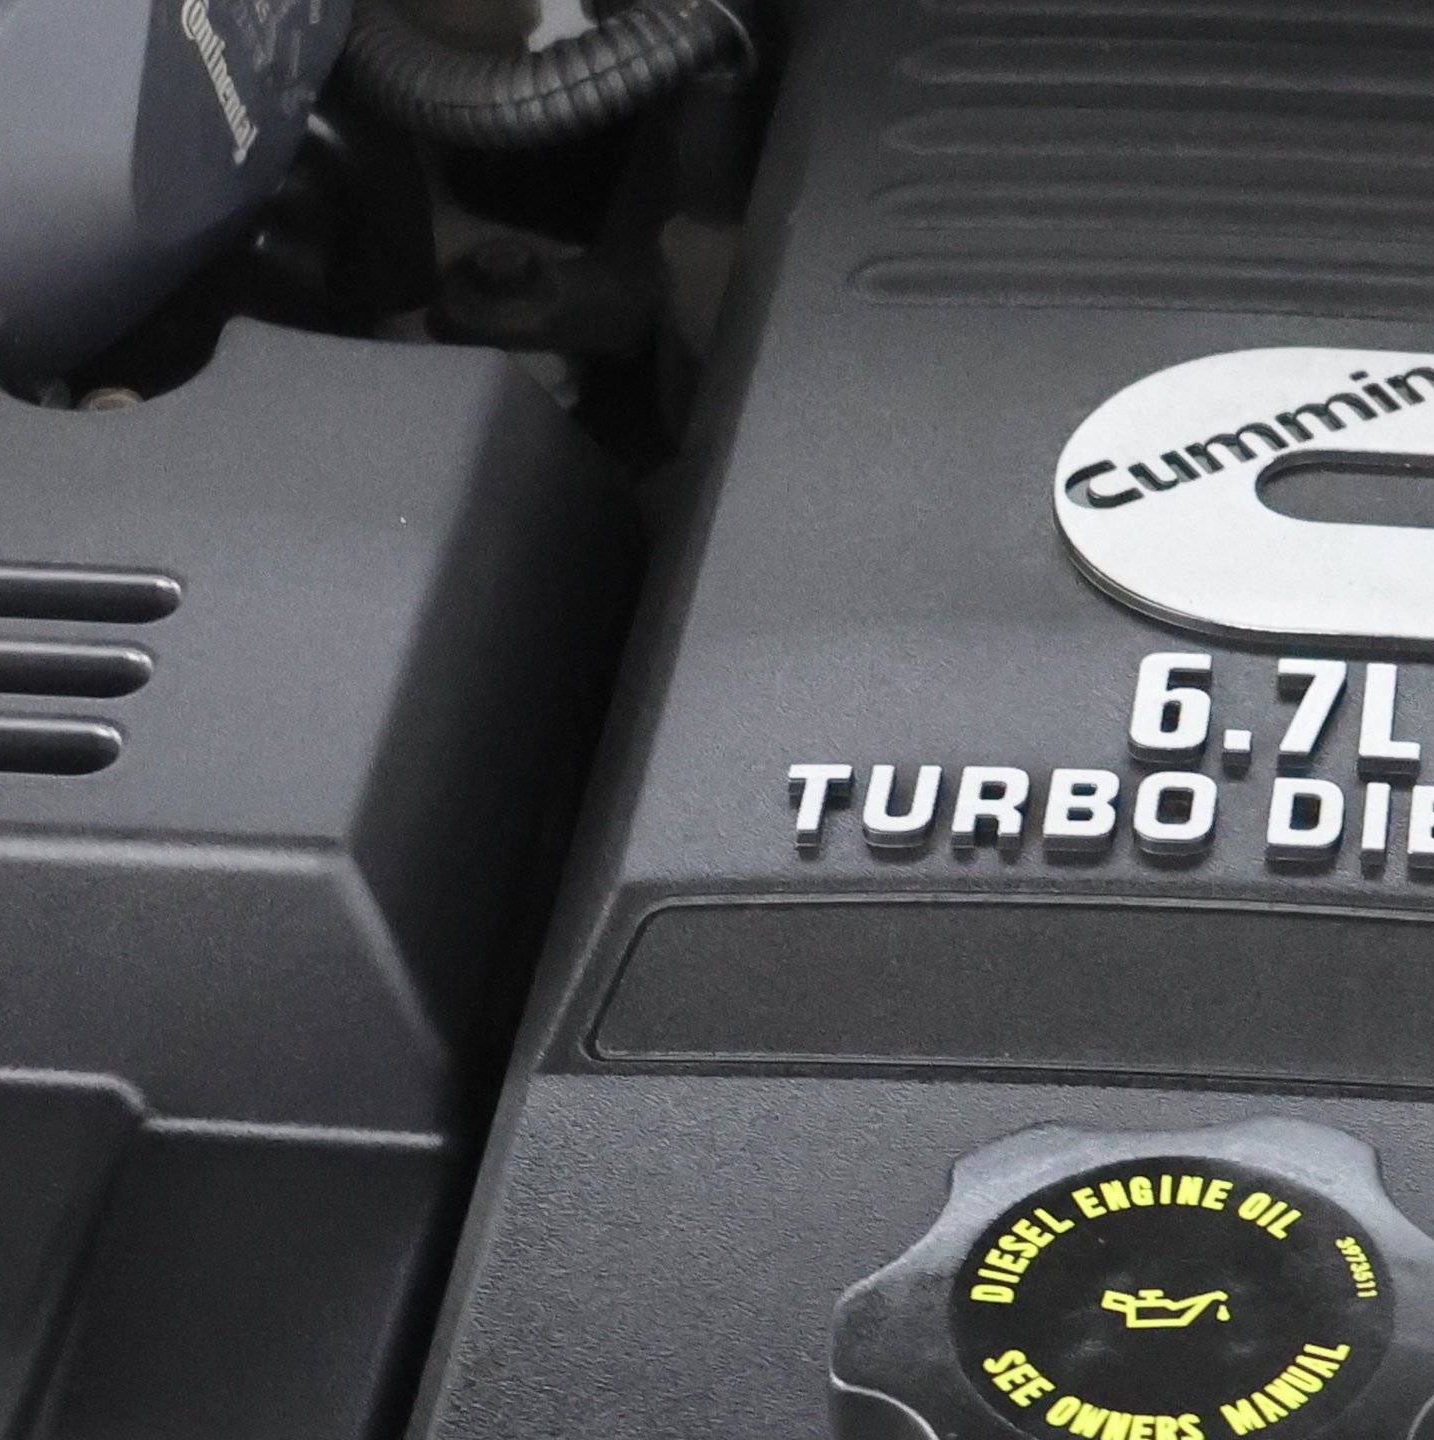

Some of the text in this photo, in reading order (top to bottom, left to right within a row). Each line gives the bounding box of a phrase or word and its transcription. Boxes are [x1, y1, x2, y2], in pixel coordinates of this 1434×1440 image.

[1128, 651, 1421, 775] 6.7L
[787, 762, 1217, 856] TURBO
[970, 1174, 1303, 1304] DIESEL ENGINE OIL
[982, 1349, 1056, 1408] SEE
[1219, 1342, 1352, 1436] MANUAL
